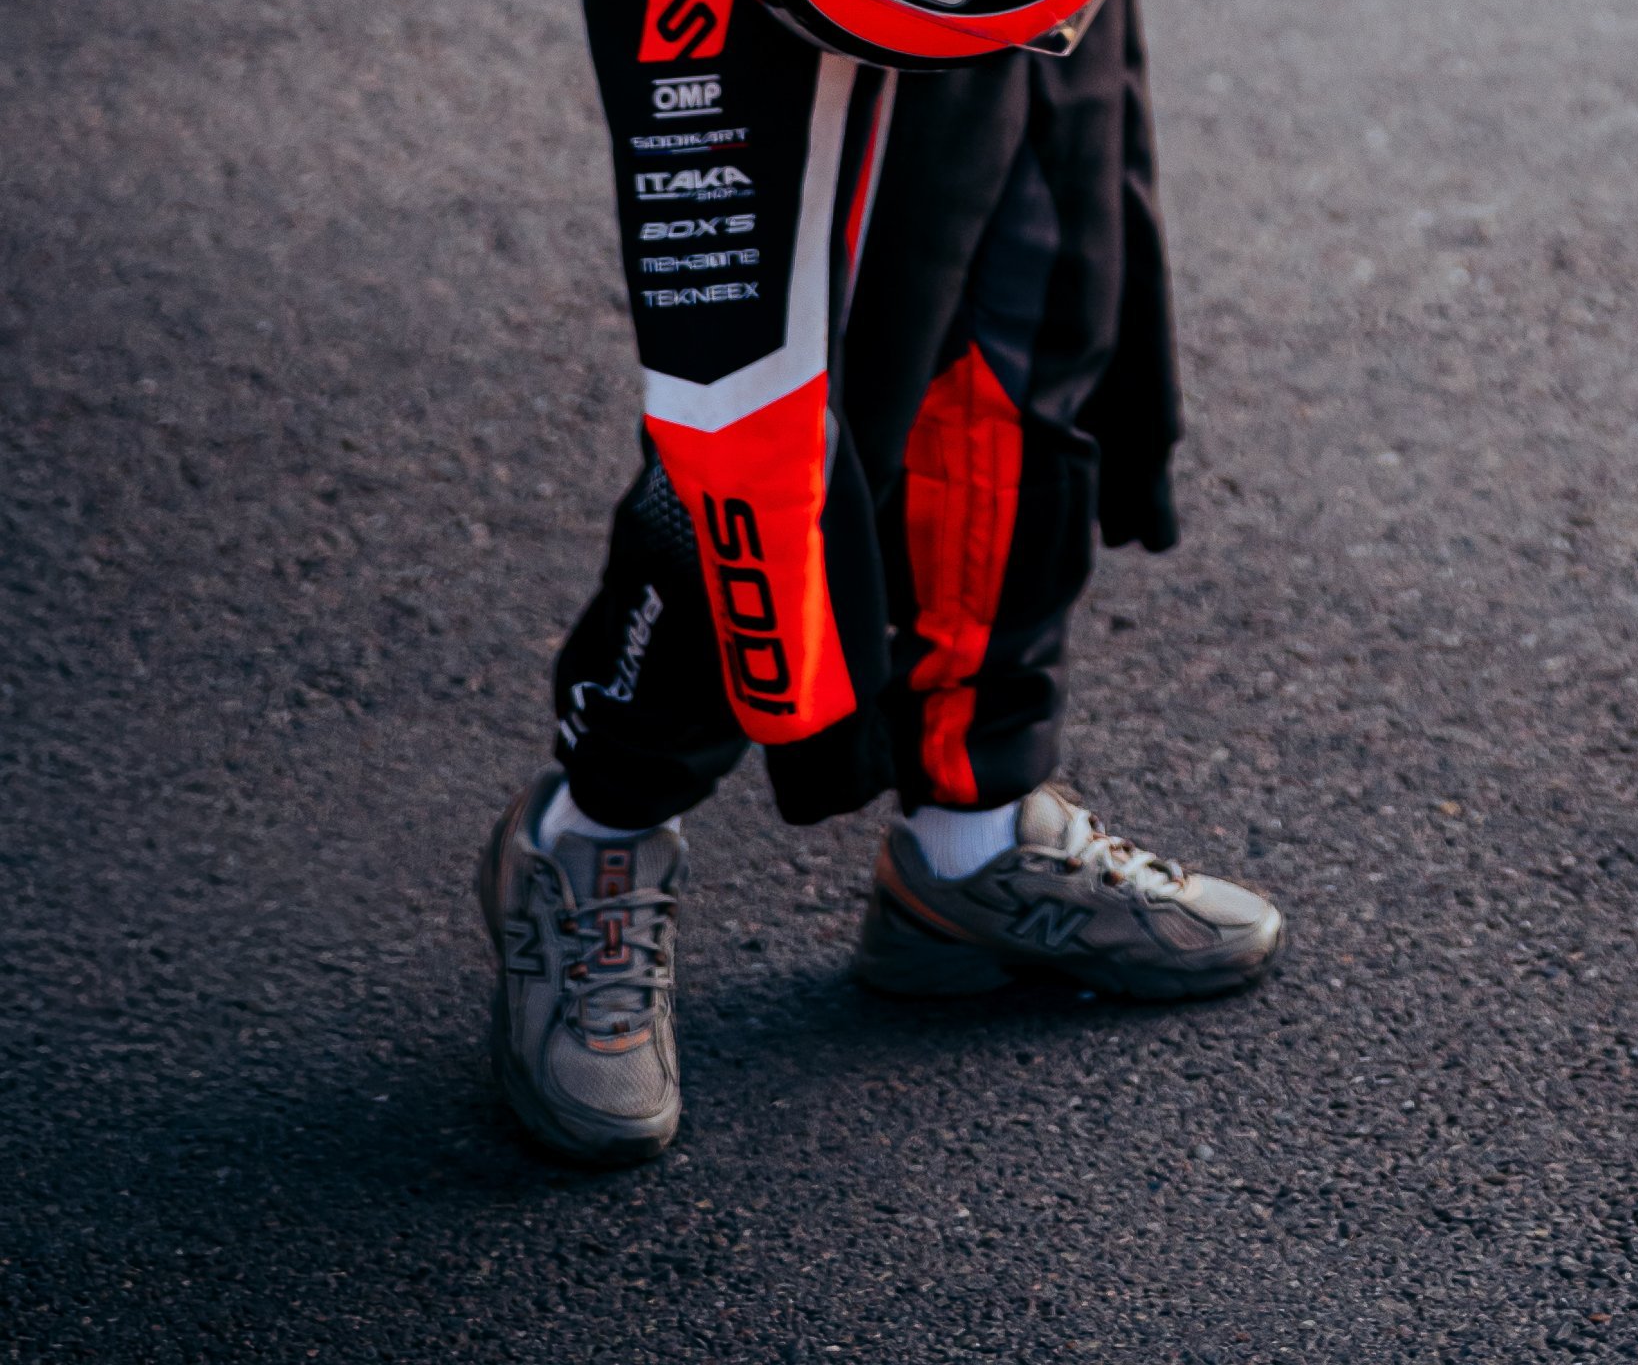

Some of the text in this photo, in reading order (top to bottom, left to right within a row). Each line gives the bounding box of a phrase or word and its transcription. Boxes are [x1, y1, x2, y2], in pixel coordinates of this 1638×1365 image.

[652, 80, 722, 111] OMP
[634, 165, 753, 193] ITAKA
[702, 490, 797, 717] SODI
